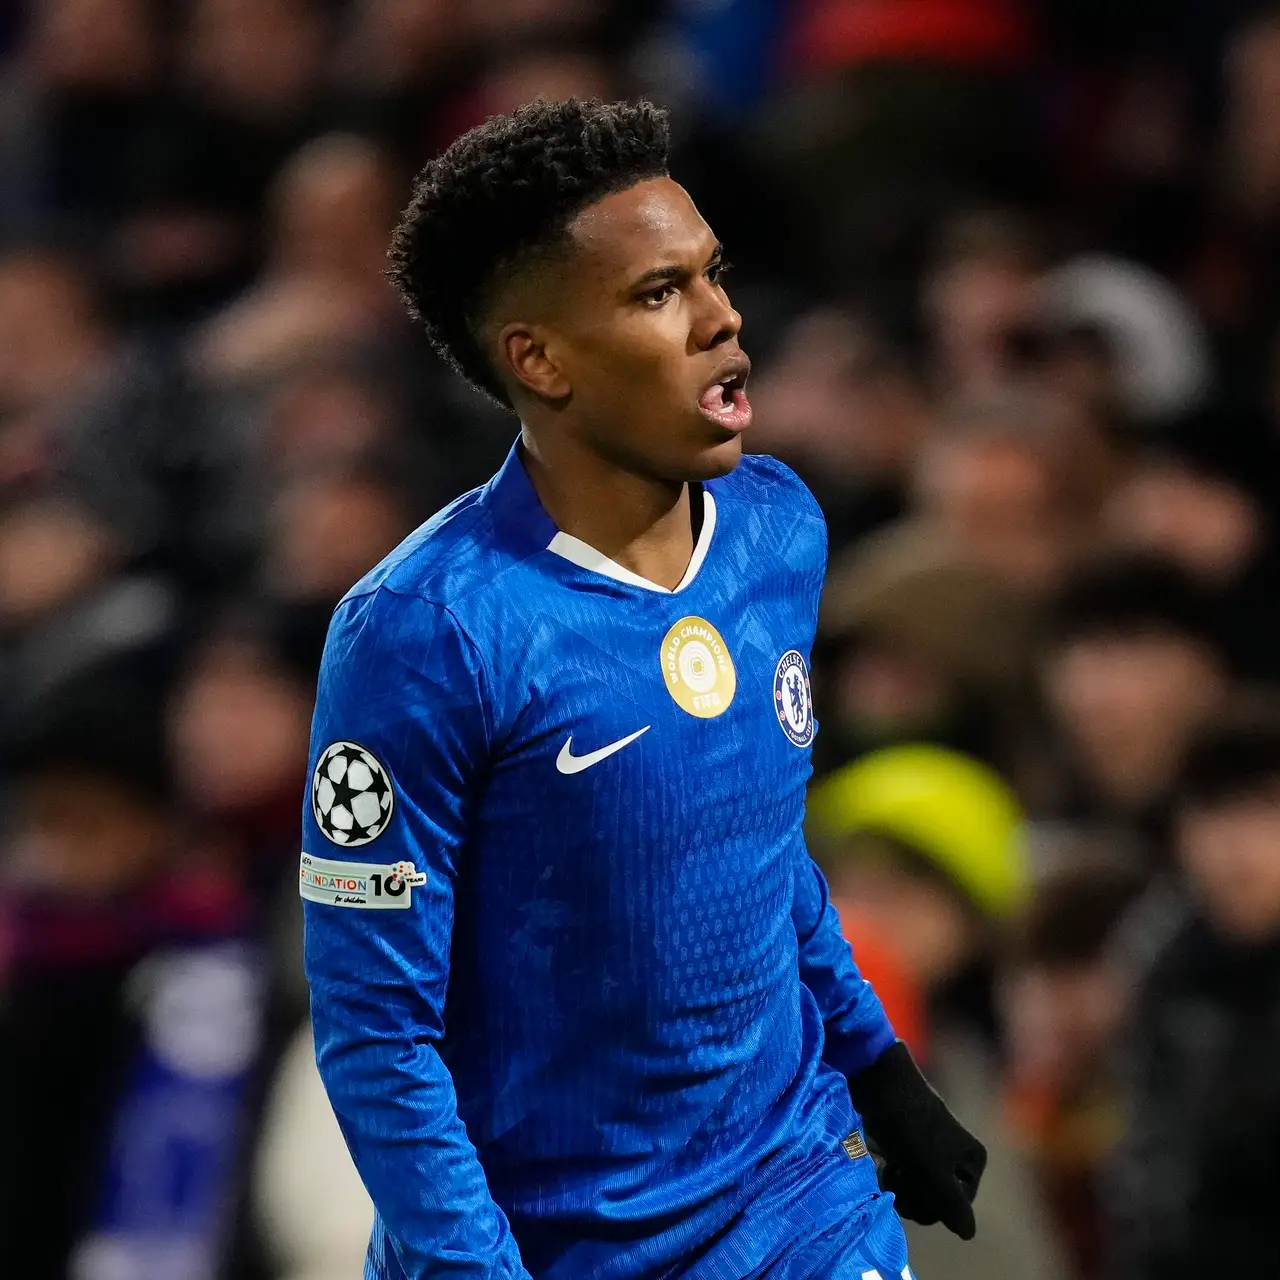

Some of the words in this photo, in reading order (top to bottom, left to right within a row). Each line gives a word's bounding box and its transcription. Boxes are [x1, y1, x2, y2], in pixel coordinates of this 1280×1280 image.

[667, 637, 681, 684] WORLD
[680, 625, 728, 672] CHAMPIONS
[778, 653, 803, 679] CHELSEA
[692, 692, 722, 710] FIFA
[301, 869, 367, 891] FOUNDATION
[369, 873, 406, 897] 10
[334, 894, 343, 904] for
[344, 895, 367, 904] children
